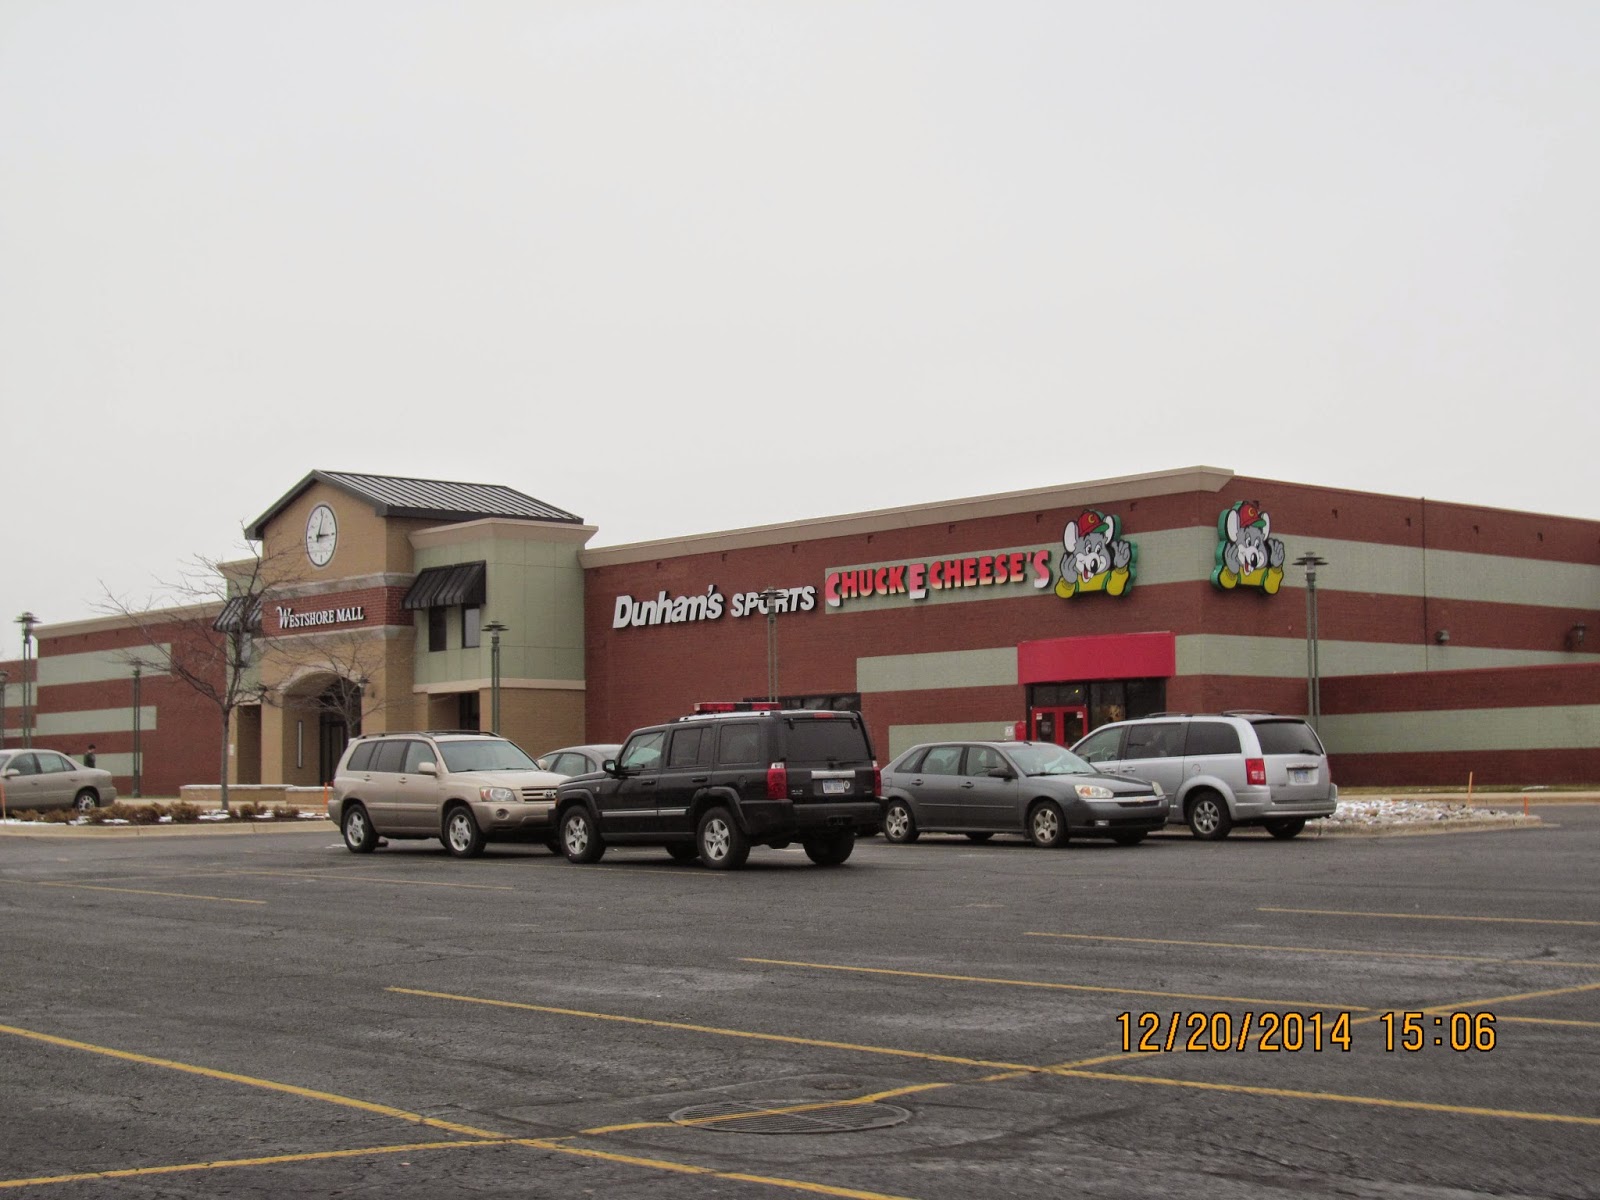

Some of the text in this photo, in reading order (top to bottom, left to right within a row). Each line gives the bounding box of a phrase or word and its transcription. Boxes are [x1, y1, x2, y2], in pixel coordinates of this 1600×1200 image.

[825, 550, 1049, 607] CHUCK E CHEESE'S
[336, 606, 364, 622] MALL
[612, 584, 724, 629] Dunham's
